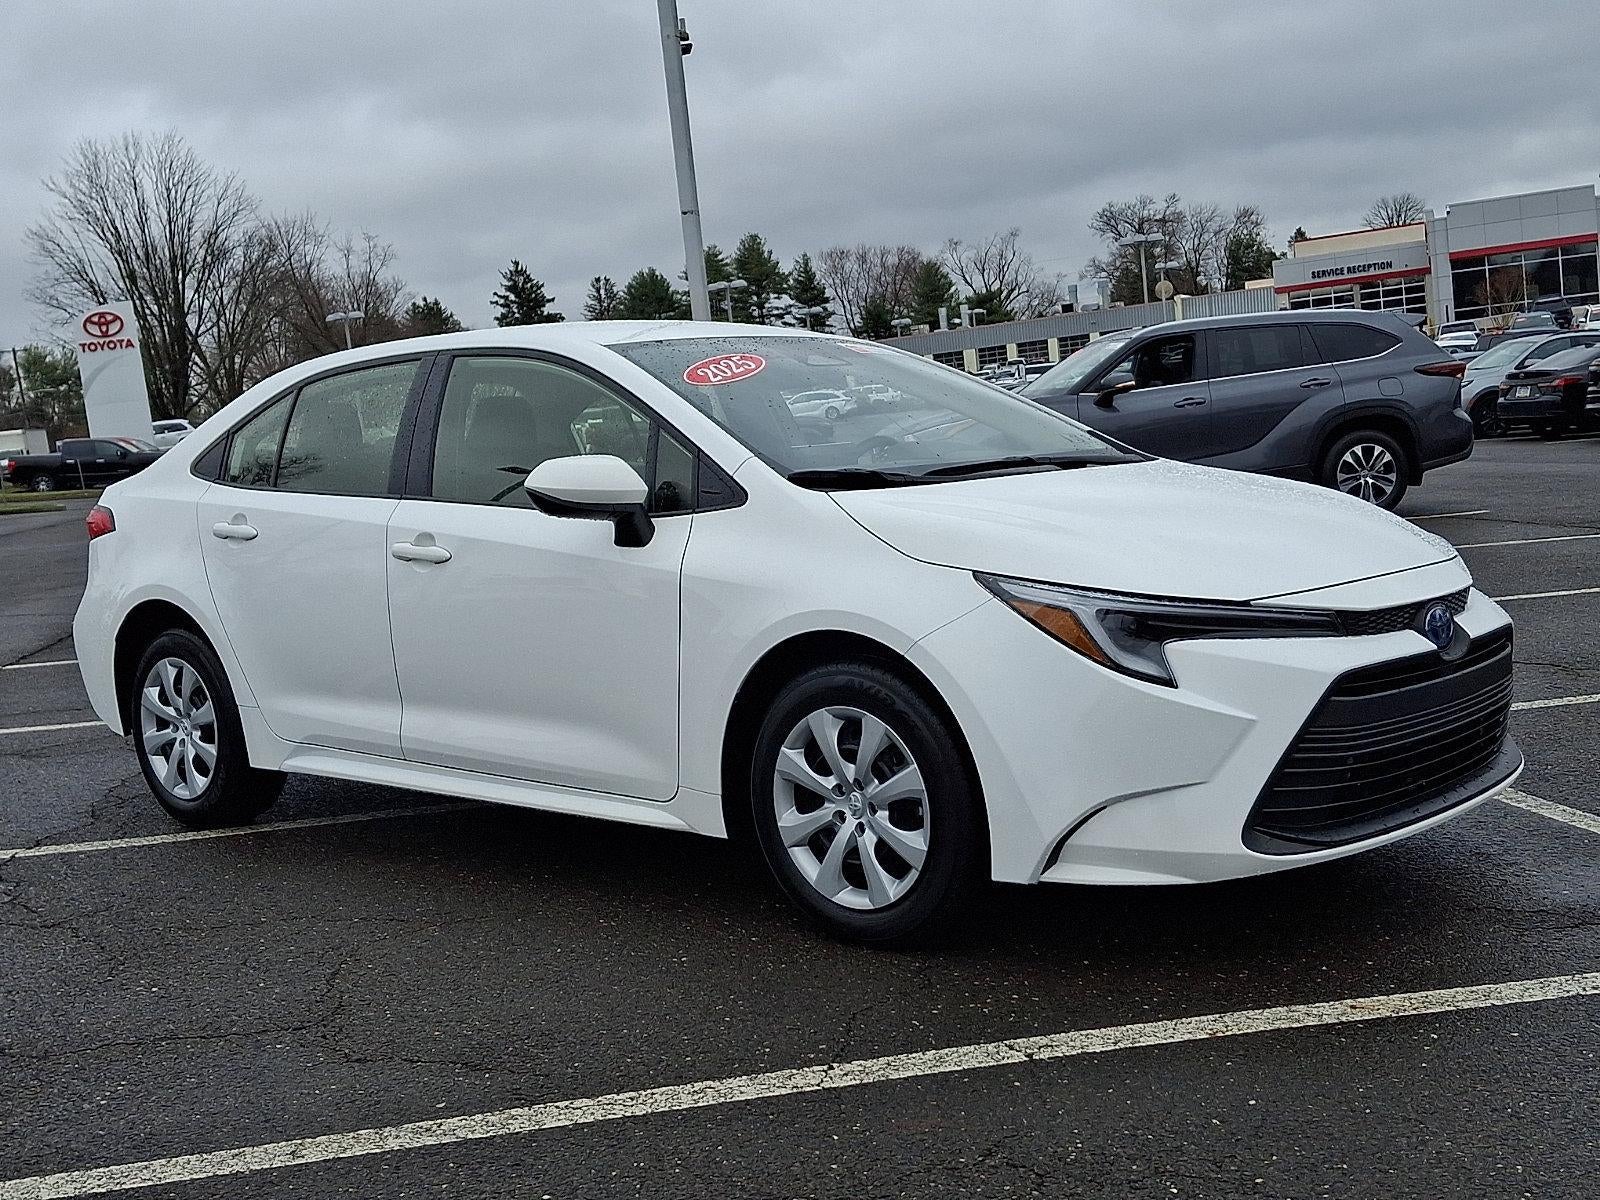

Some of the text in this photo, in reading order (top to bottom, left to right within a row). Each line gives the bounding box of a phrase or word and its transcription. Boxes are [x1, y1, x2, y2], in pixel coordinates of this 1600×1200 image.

[1311, 260, 1393, 279] SERVICE RECEPTION
[79, 338, 135, 353] TOYOTA
[697, 355, 756, 382] 2025
